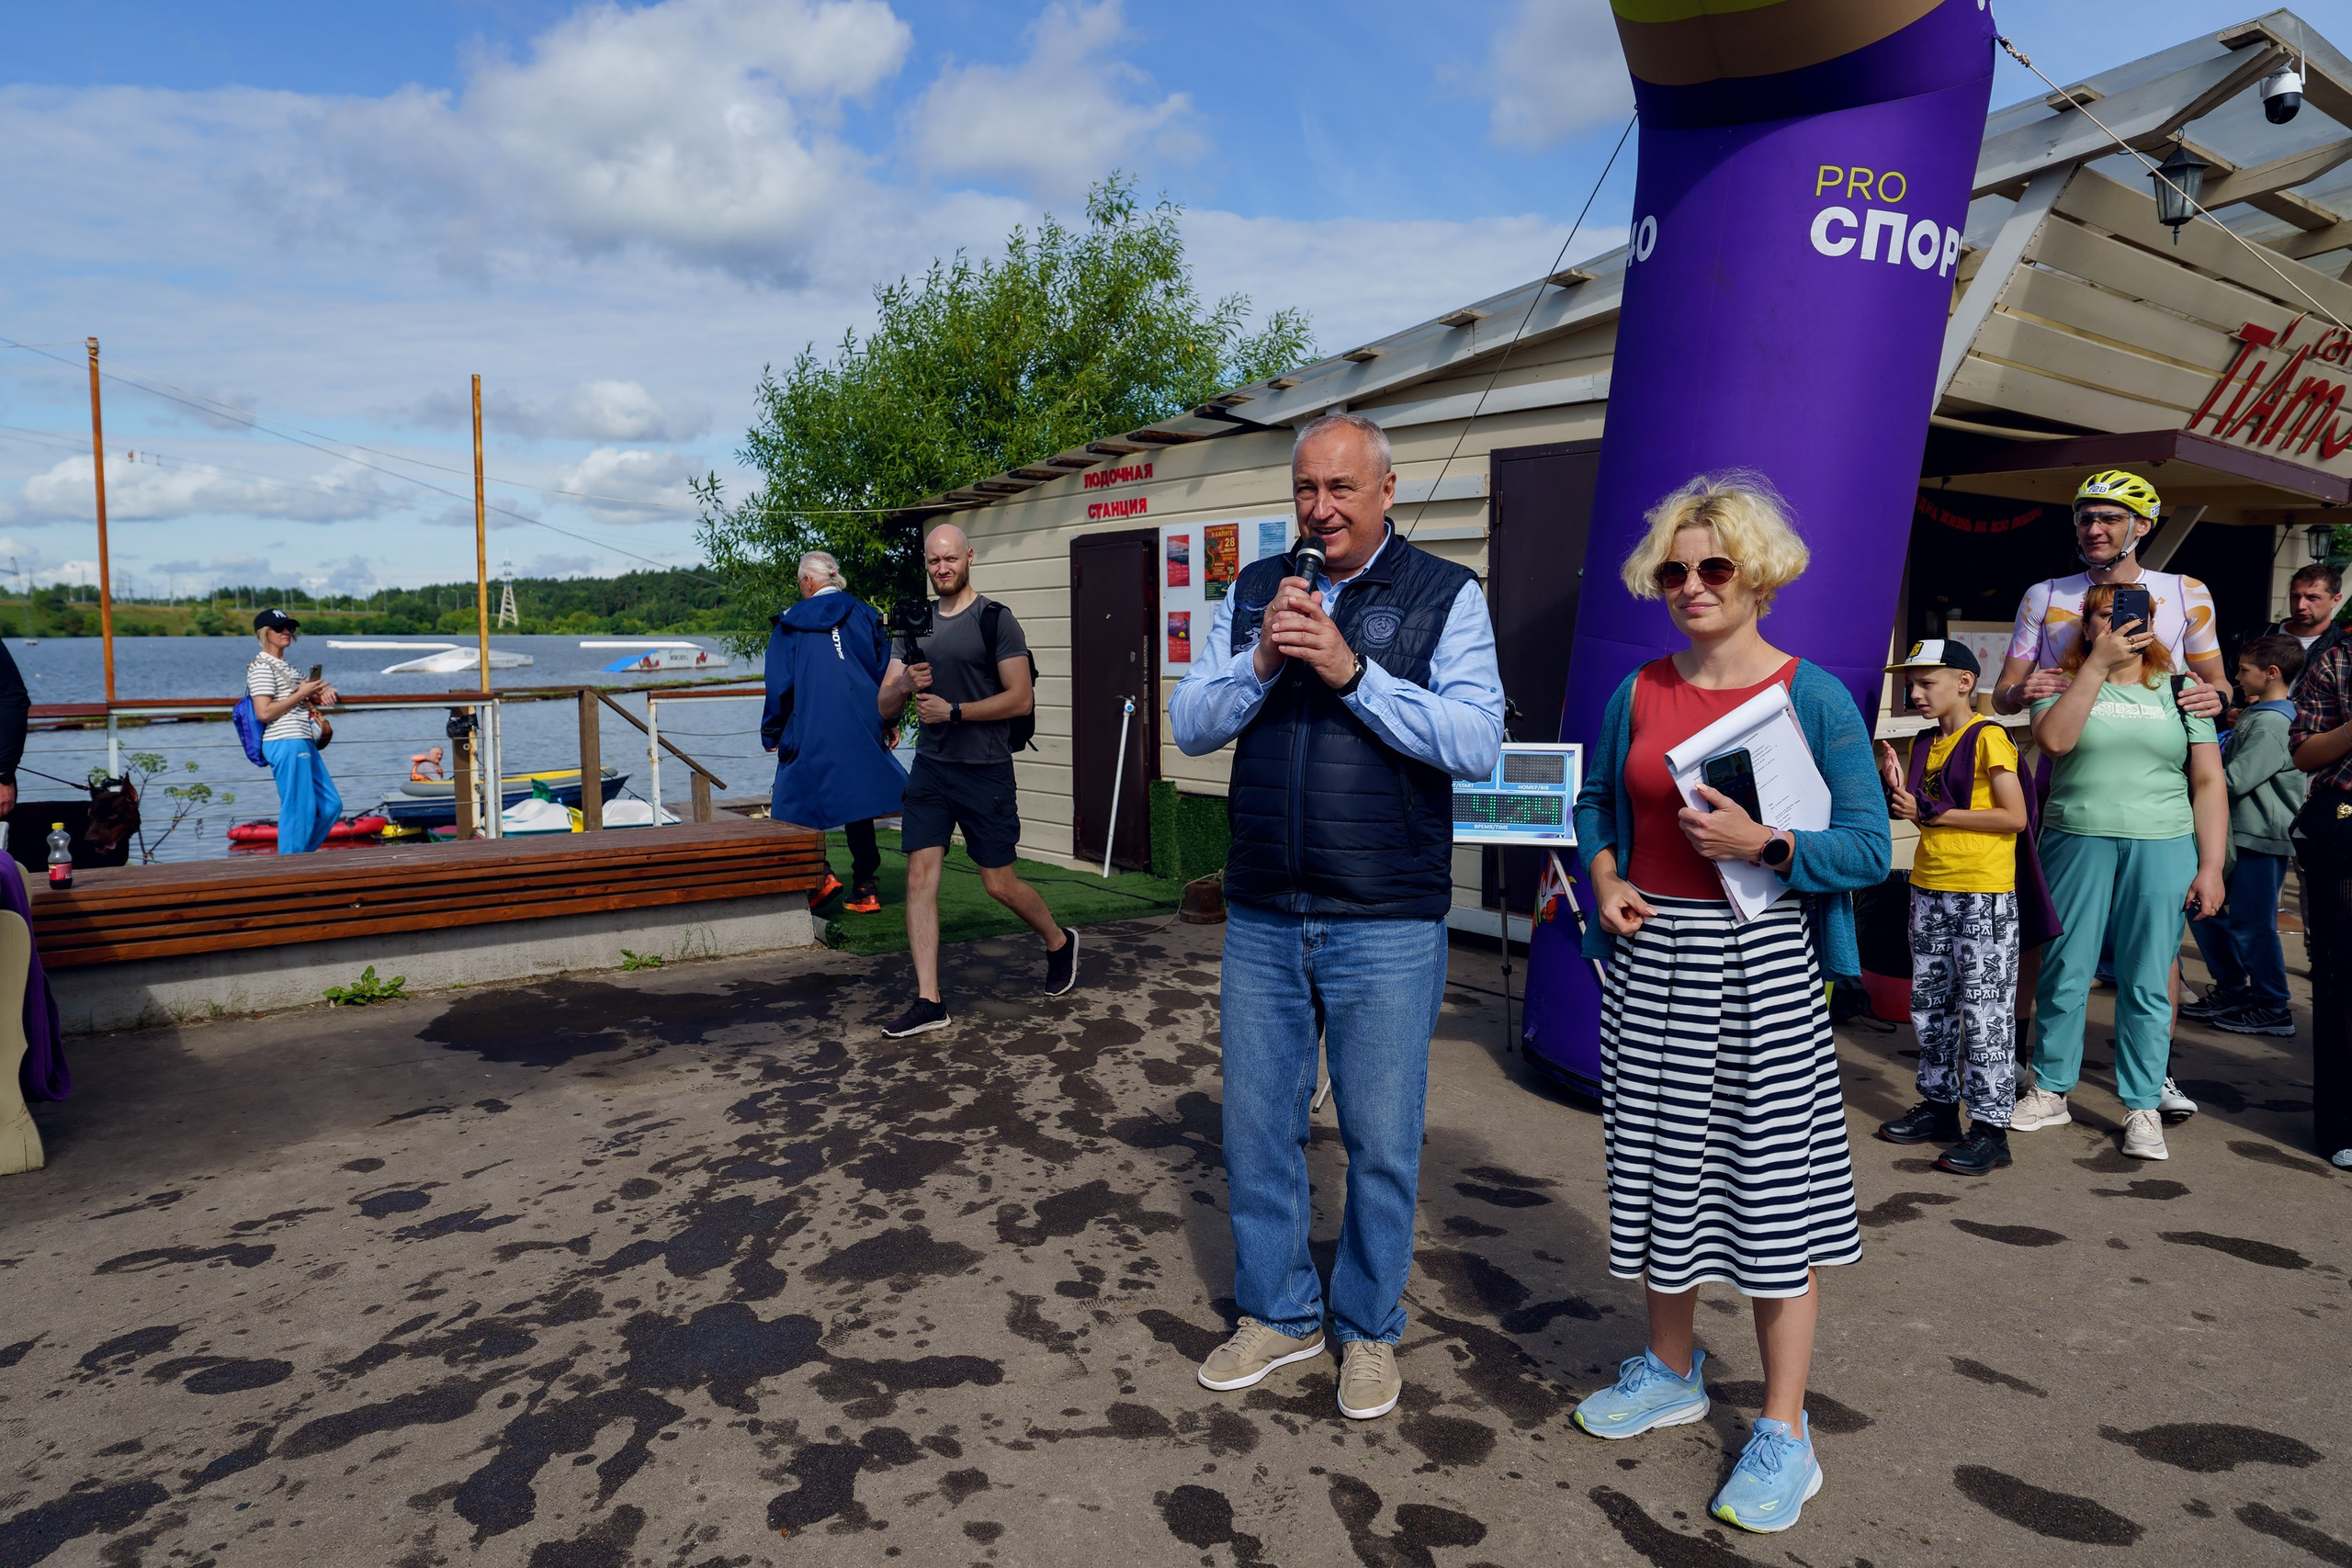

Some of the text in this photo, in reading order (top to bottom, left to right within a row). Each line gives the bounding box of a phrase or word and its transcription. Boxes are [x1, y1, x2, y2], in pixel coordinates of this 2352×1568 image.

[1815, 164, 1907, 203] PRO
[1810, 206, 1963, 278] СПОР
[1084, 462, 1153, 489] ЛОДОЧНАЯ
[2087, 485, 2108, 493] 128
[1088, 497, 1148, 519] СТАНЦИЯ
[1224, 536, 1236, 547] 28
[1969, 1050, 2007, 1063] JAPAN
